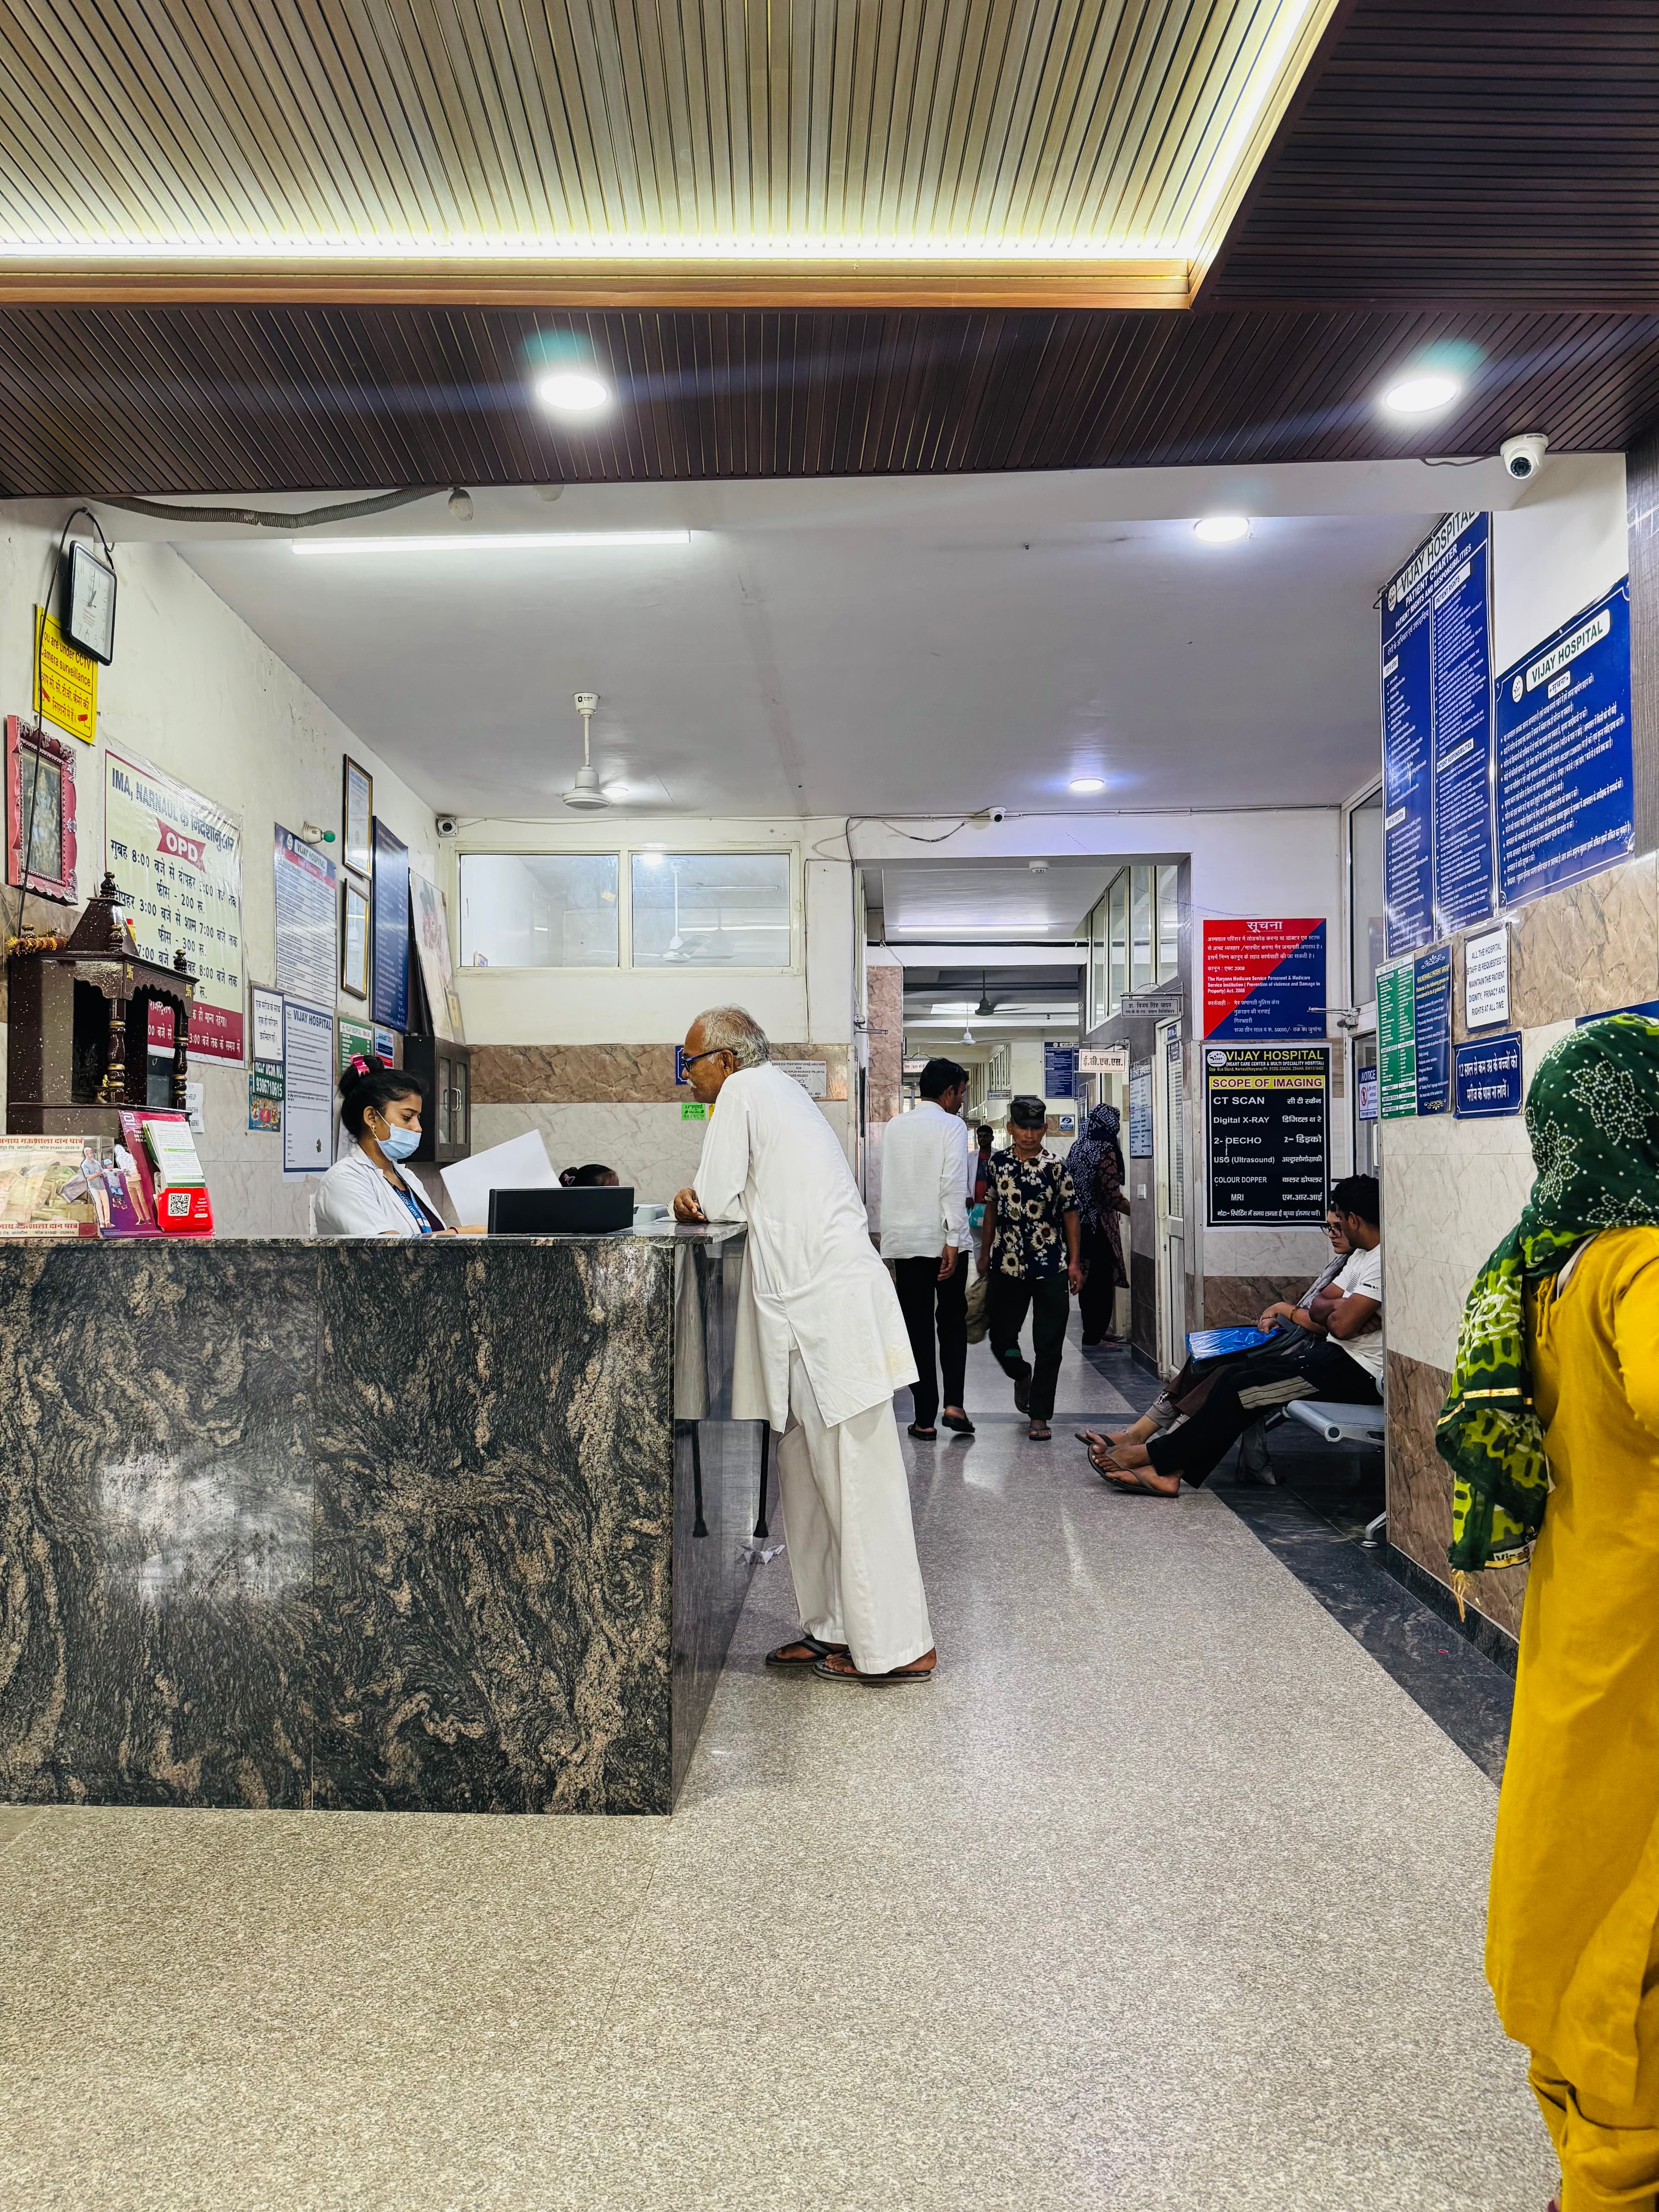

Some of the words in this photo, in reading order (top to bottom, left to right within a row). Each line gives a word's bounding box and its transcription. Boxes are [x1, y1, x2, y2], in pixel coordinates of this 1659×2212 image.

[1401, 552, 1424, 593] VIJAY
[1406, 577, 1428, 607] PATIENT
[1430, 543, 1457, 578] CHARTER
[1395, 605, 1410, 629] PATIENT
[1410, 595, 1424, 614] RIGHTS
[1425, 587, 1433, 599] AND
[1433, 543, 1471, 590] RESPONSIBILITIES
[1436, 588, 1448, 605] PATIENT
[1449, 575, 1460, 592] RIGHTS
[78, 623, 82, 636] 7
[85, 629, 89, 642] 6
[60, 642, 74, 659] under
[76, 652, 91, 670] CCTV
[1532, 655, 1555, 682] VIJAY
[1558, 621, 1602, 664] HOSPITAL
[41, 644, 58, 666] Camera
[60, 661, 90, 686] surveillance
[1437, 759, 1447, 770] PATIENT
[1448, 742, 1472, 763] RESPONSIBILITIES
[112, 767, 133, 801] IMA,
[166, 831, 199, 863] OPD
[297, 843, 308, 857] VIJAY
[111, 839, 128, 860] सुबह
[132, 849, 150, 868] 8:00
[154, 857, 165, 876] बजे
[169, 862, 175, 880] से
[178, 867, 195, 890] दोपहर
[181, 893, 194, 909] 200
[140, 902, 157, 917] 3:00
[161, 905, 171, 924] बजे
[175, 909, 181, 927] से
[184, 916, 197, 933] शाम
[199, 922, 214, 939] 7:00
[217, 928, 226, 944] बजे
[229, 934, 238, 948] तक
[1246, 922, 1283, 932] सूचना
[182, 938, 195, 950] 300
[1485, 943, 1502, 954] HOSPITAL
[137, 944, 155, 960] 7:00
[159, 948, 169, 966] बजे
[1467, 965, 1477, 975] STAFF
[1482, 957, 1502, 970] REQUESTED
[1502, 955, 1506, 963] TO
[199, 965, 213, 979] 8:00
[216, 968, 226, 985] बजे
[229, 974, 238, 987] तक
[1469, 977, 1484, 988] MAINTAIN
[1492, 971, 1505, 981] PATIENT
[1484, 988, 1497, 998] PRIVACY
[293, 1009, 308, 1025] VIJAY
[309, 1014, 331, 1030] HOSPITAL
[1471, 1006, 1484, 1016] RIGHTS
[1226, 1051, 1260, 1061] VIJAY
[1264, 1050, 1324, 1060] HOSPITAL
[1459, 1064, 1464, 1077] 12
[1465, 1062, 1473, 1077] साल
[1478, 1061, 1486, 1074] कम
[1510, 1049, 1517, 1069] को
[255, 1062, 264, 1074] HELP
[1361, 1070, 1376, 1081] NOTICE
[1213, 1079, 1251, 1087] SCOPE
[1255, 1079, 1269, 1087] OF
[1274, 1078, 1322, 1087] IMAGING
[1467, 1084, 1477, 1102] मरीज
[1483, 1087, 1491, 1100] पास
[1213, 1116, 1240, 1125] Digital
[1232, 1156, 1275, 1164] (Ultrasound)
